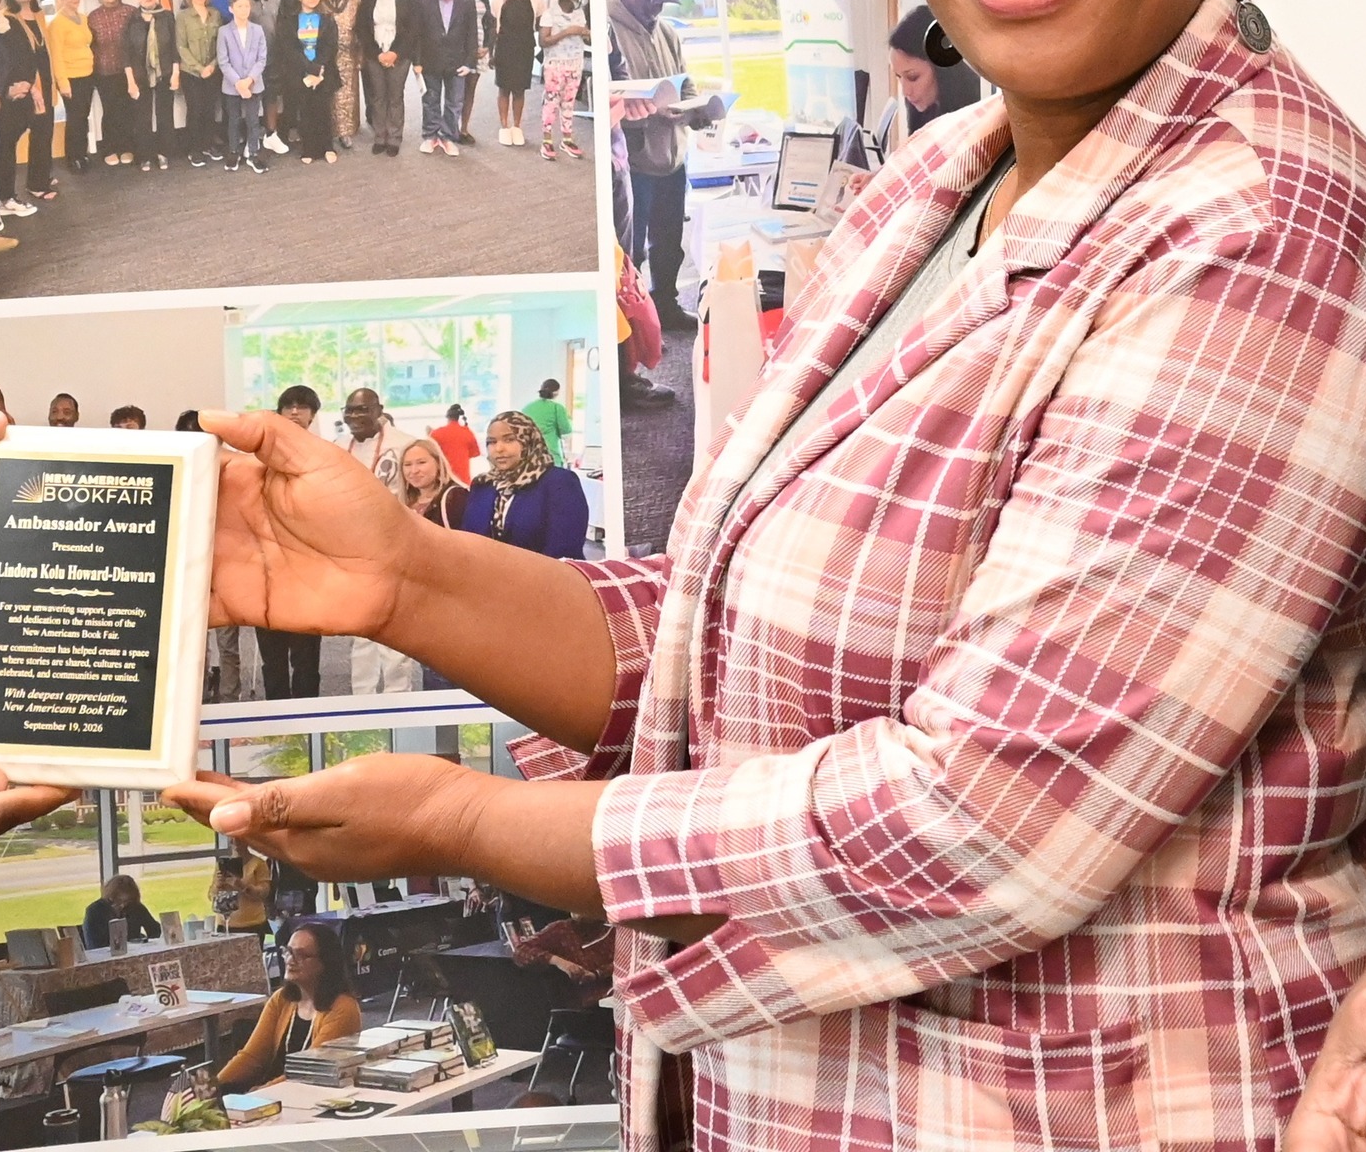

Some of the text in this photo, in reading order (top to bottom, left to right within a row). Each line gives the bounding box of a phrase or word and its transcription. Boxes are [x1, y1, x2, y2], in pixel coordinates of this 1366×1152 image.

[45, 472, 153, 487] NEW AMERICANS
[43, 487, 153, 505] BOOKFAIR
[4, 514, 156, 534] Ambassador Award
[52, 542, 104, 553] Presented to
[40, 563, 65, 580] Kolu
[0, 601, 147, 617] For your unwavering support, generosity,
[8, 615, 22, 623] and
[23, 616, 61, 625] dedication
[72, 617, 83, 626] the
[85, 618, 113, 627] mission
[114, 618, 123, 627] of
[124, 619, 136, 628] the
[22, 627, 119, 640] New Americans Book Fair.
[10, 643, 56, 653] commitment
[58, 645, 70, 654] has
[72, 645, 97, 656] helped
[98, 647, 121, 656] create
[129, 649, 150, 659] space
[2, 655, 24, 665] where
[26, 656, 50, 666] stories
[65, 658, 91, 668] shared,
[93, 659, 122, 668] cultures
[37, 670, 50, 679] and
[52, 671, 99, 681] communities
[114, 673, 140, 682] united.
[4, 688, 127, 704] With deepest appreciation,
[2, 701, 127, 716] New Americans Book Fair
[24, 720, 103, 732] September 19, 2026
